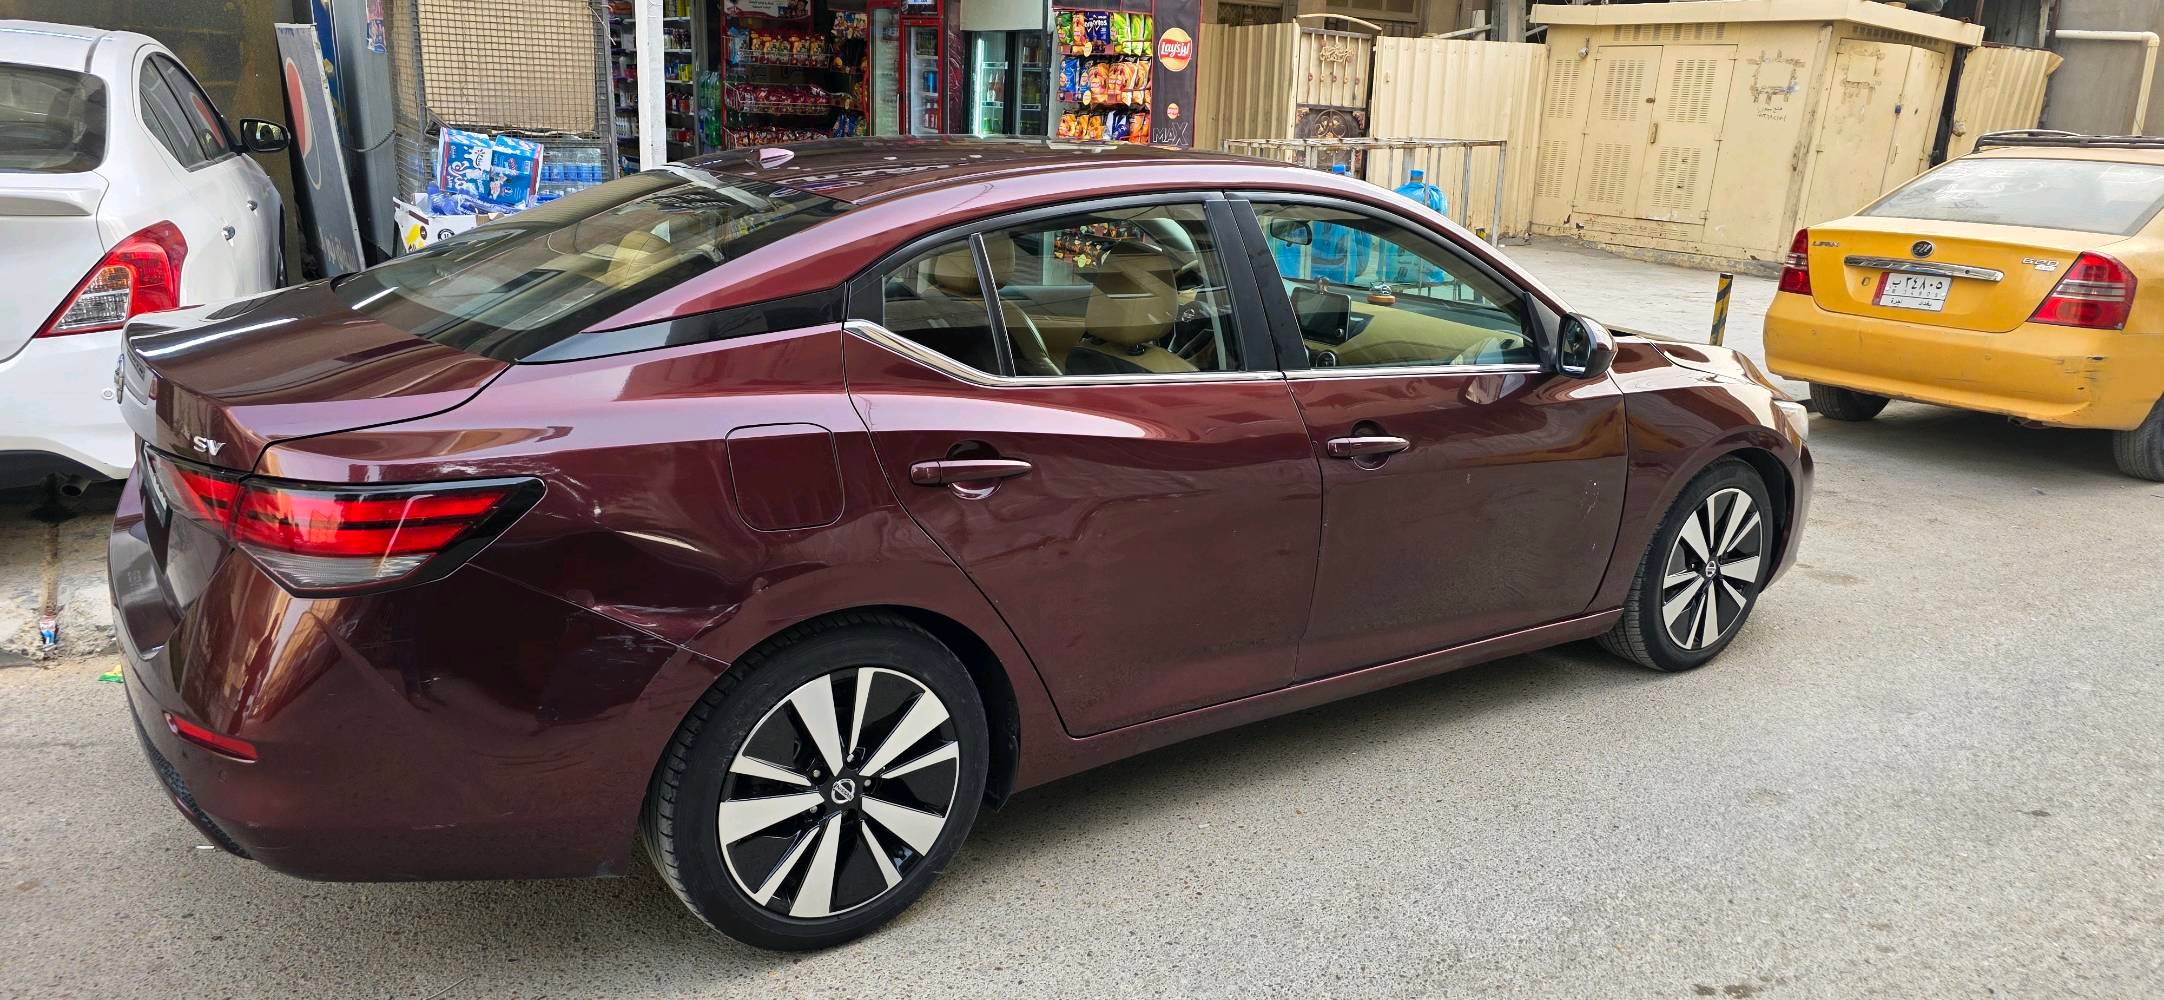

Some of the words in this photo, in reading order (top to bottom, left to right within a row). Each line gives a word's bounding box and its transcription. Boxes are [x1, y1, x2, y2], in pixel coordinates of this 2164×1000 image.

[1161, 41, 1180, 57] Lay's
[1153, 122, 1188, 145] MAX
[1892, 279, 1901, 288] ب
[193, 435, 227, 456] SV
